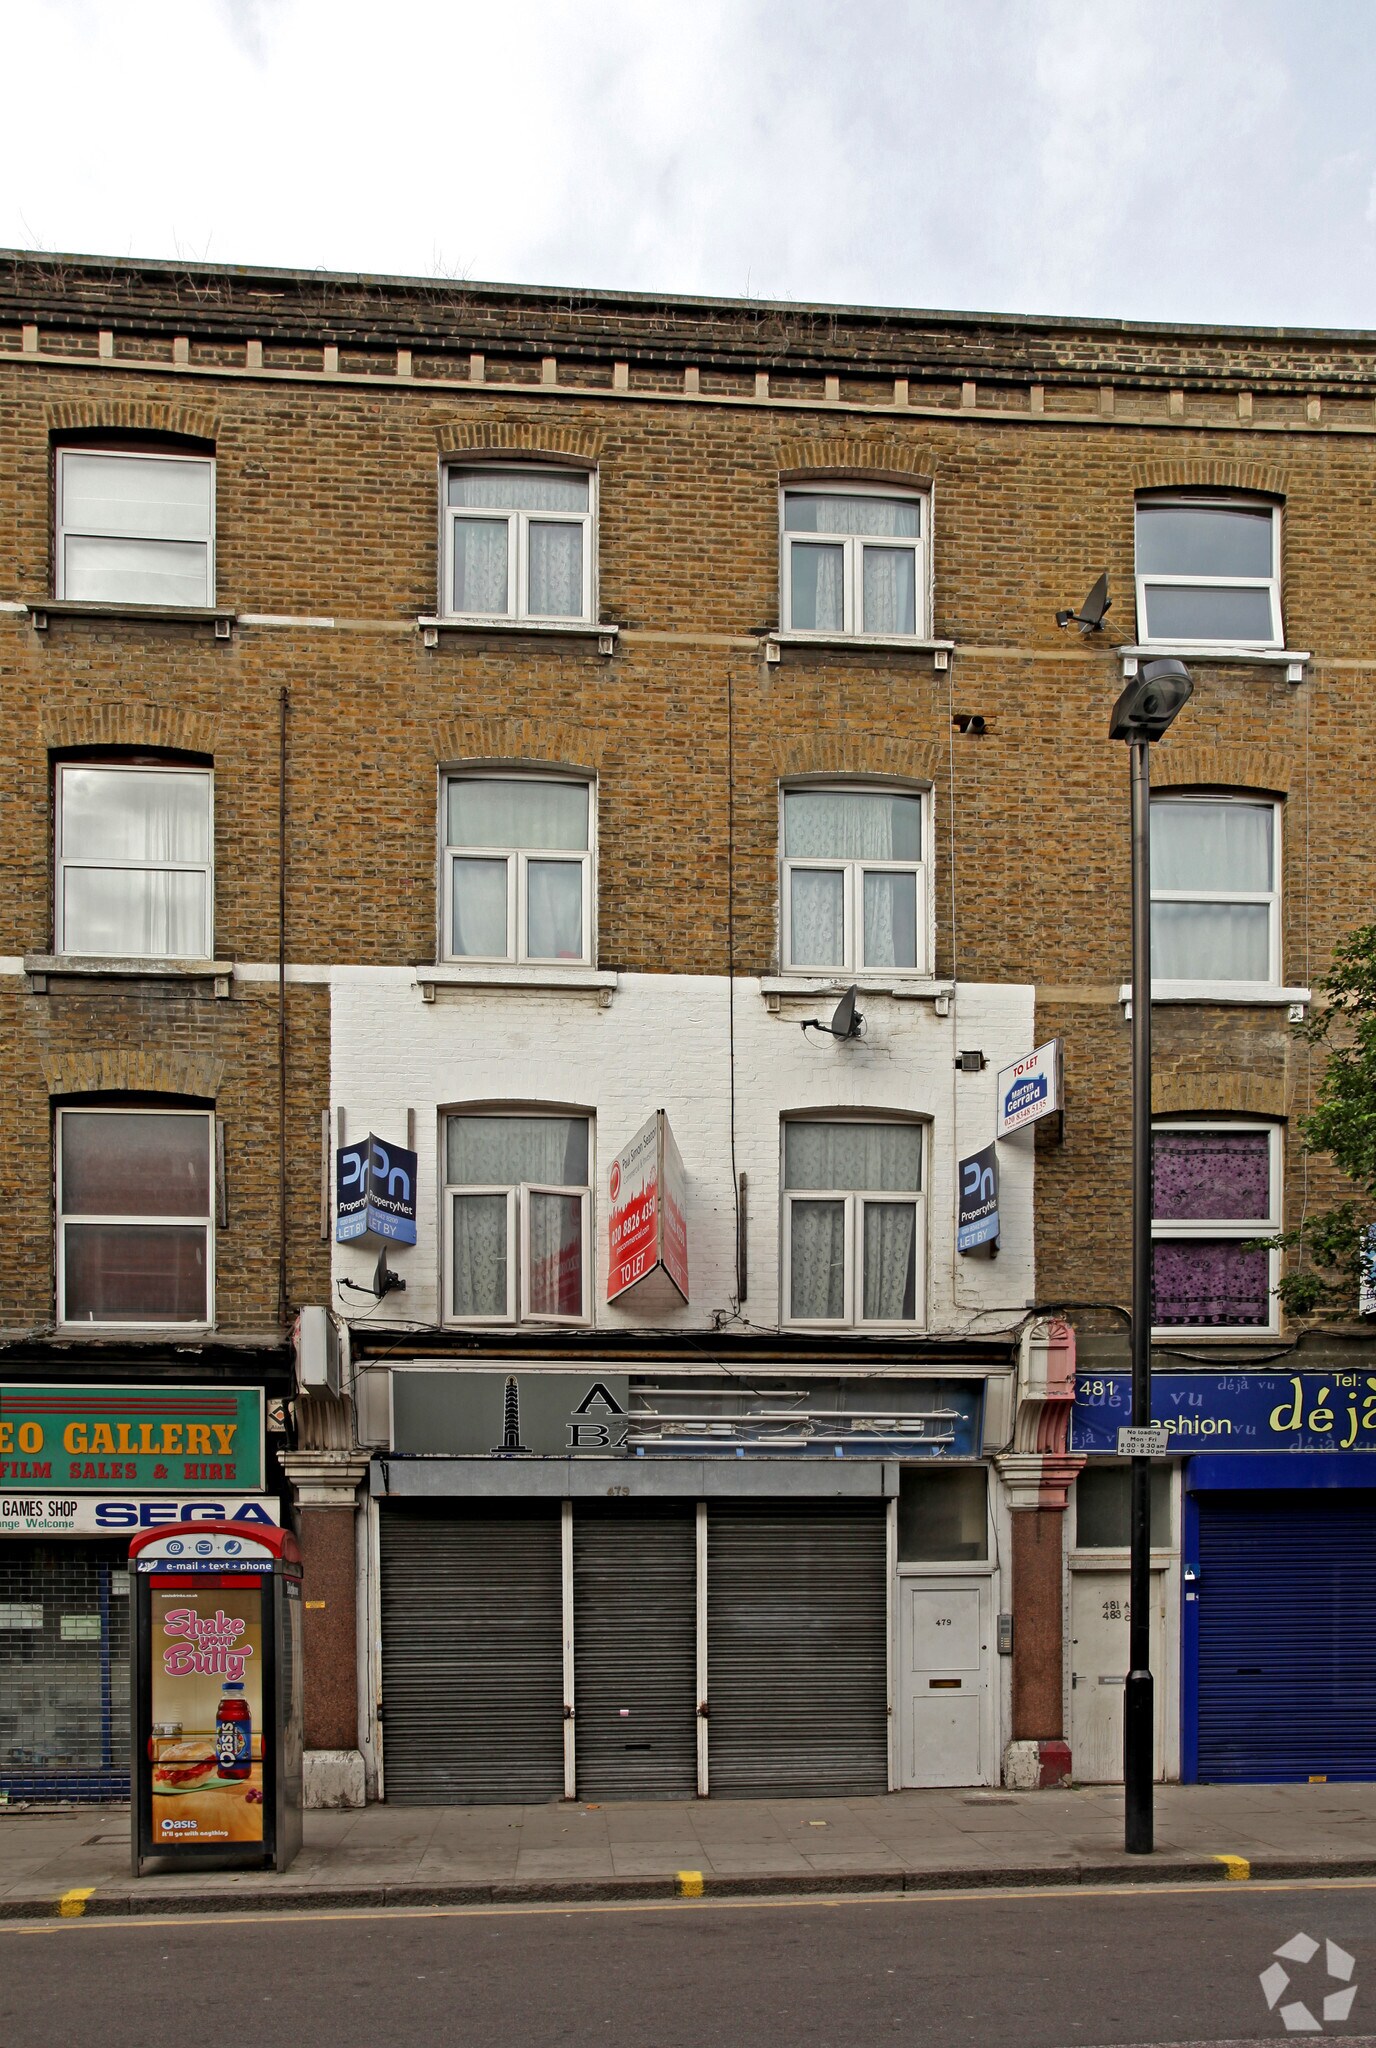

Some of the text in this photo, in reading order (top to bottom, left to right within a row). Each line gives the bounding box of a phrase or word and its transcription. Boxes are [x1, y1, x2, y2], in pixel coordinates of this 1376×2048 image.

[1013, 1055, 1038, 1077] TO LET
[1007, 1086, 1040, 1113] Gerrard
[1011, 1082, 1034, 1100] Martyn
[369, 1190, 413, 1215] PropertyNet
[961, 1199, 997, 1222] PropertyNet
[338, 1220, 365, 1239] LET BY
[369, 1216, 397, 1236] LET BY
[611, 1228, 621, 1246] 020
[623, 1210, 640, 1237] 8826
[960, 1228, 988, 1248] LET BY
[621, 1264, 631, 1285] TO
[632, 1252, 646, 1278] LET
[1079, 1380, 1115, 1396] 481
[1217, 1376, 1275, 1395] déjà vu
[1335, 1372, 1362, 1387] Tel:
[1170, 1391, 1203, 1407] vu
[1150, 1414, 1232, 1435] ashion
[1232, 1424, 1256, 1435] vu
[63, 1422, 238, 1456] GALLERY
[1071, 1428, 1096, 1449] éjà
[0, 1461, 237, 1480] FILM SALES & HIRE
[607, 1485, 630, 1496] 479
[2, 1500, 78, 1517] GAMES SHOP
[95, 1502, 280, 1528] SEGA
[0, 1518, 75, 1531] nge Welcome
[166, 1559, 198, 1570] e-mail
[209, 1561, 230, 1570] text
[240, 1559, 272, 1572] phone
[1102, 1600, 1120, 1611] 481
[163, 1608, 246, 1640] Shake
[935, 1619, 952, 1627] 479
[1102, 1610, 1122, 1621] 483
[198, 1634, 237, 1651] your
[163, 1642, 254, 1682] Butty
[220, 1722, 236, 1768] Oasis
[161, 1818, 198, 1830] Oasis
